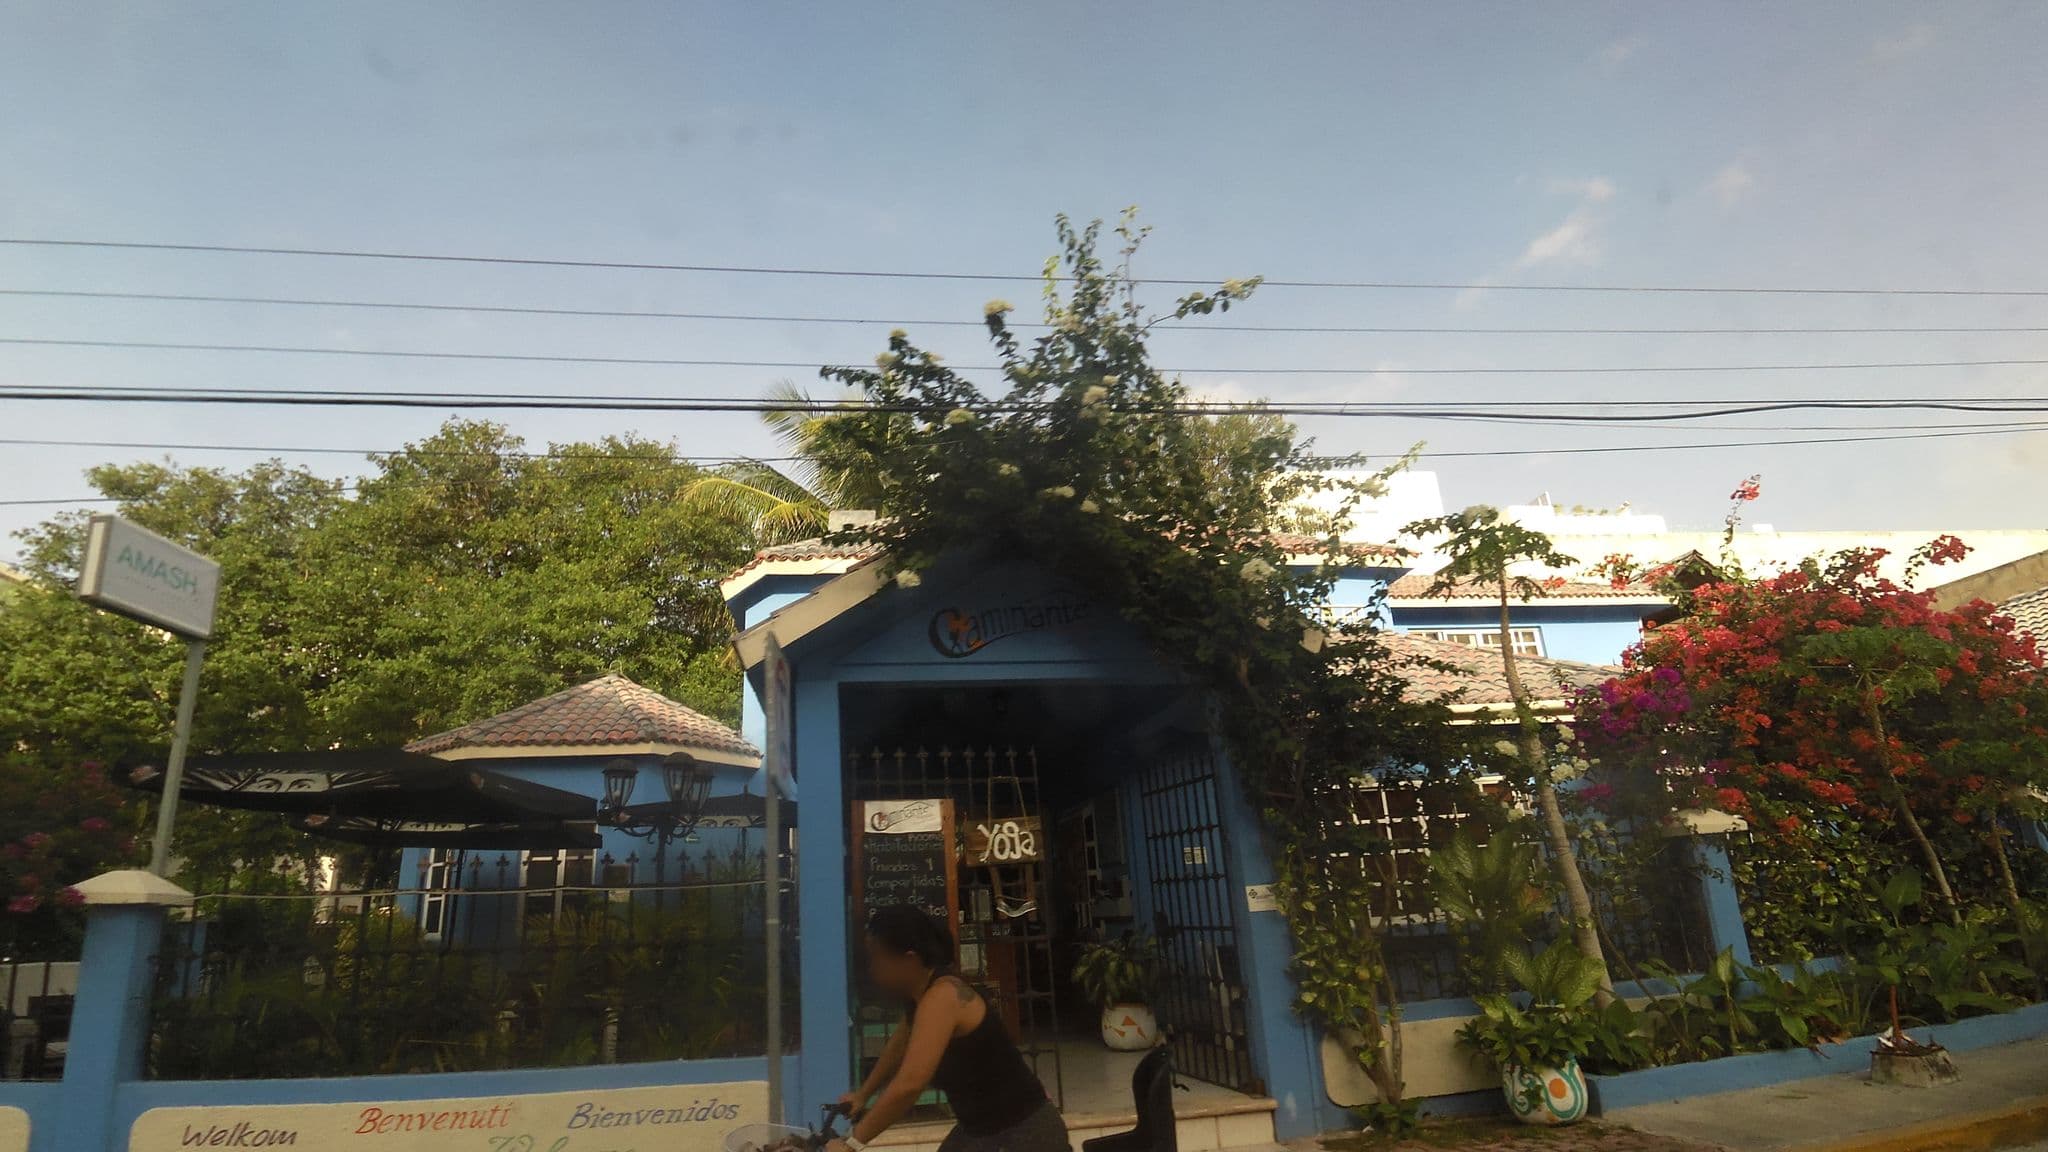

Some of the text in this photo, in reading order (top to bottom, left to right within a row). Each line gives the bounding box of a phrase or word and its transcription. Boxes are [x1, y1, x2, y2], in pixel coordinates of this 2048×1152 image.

[117, 544, 198, 594] AMASH
[182, 1098, 740, 1148] Welkom Benvenuti Bienvenidos
